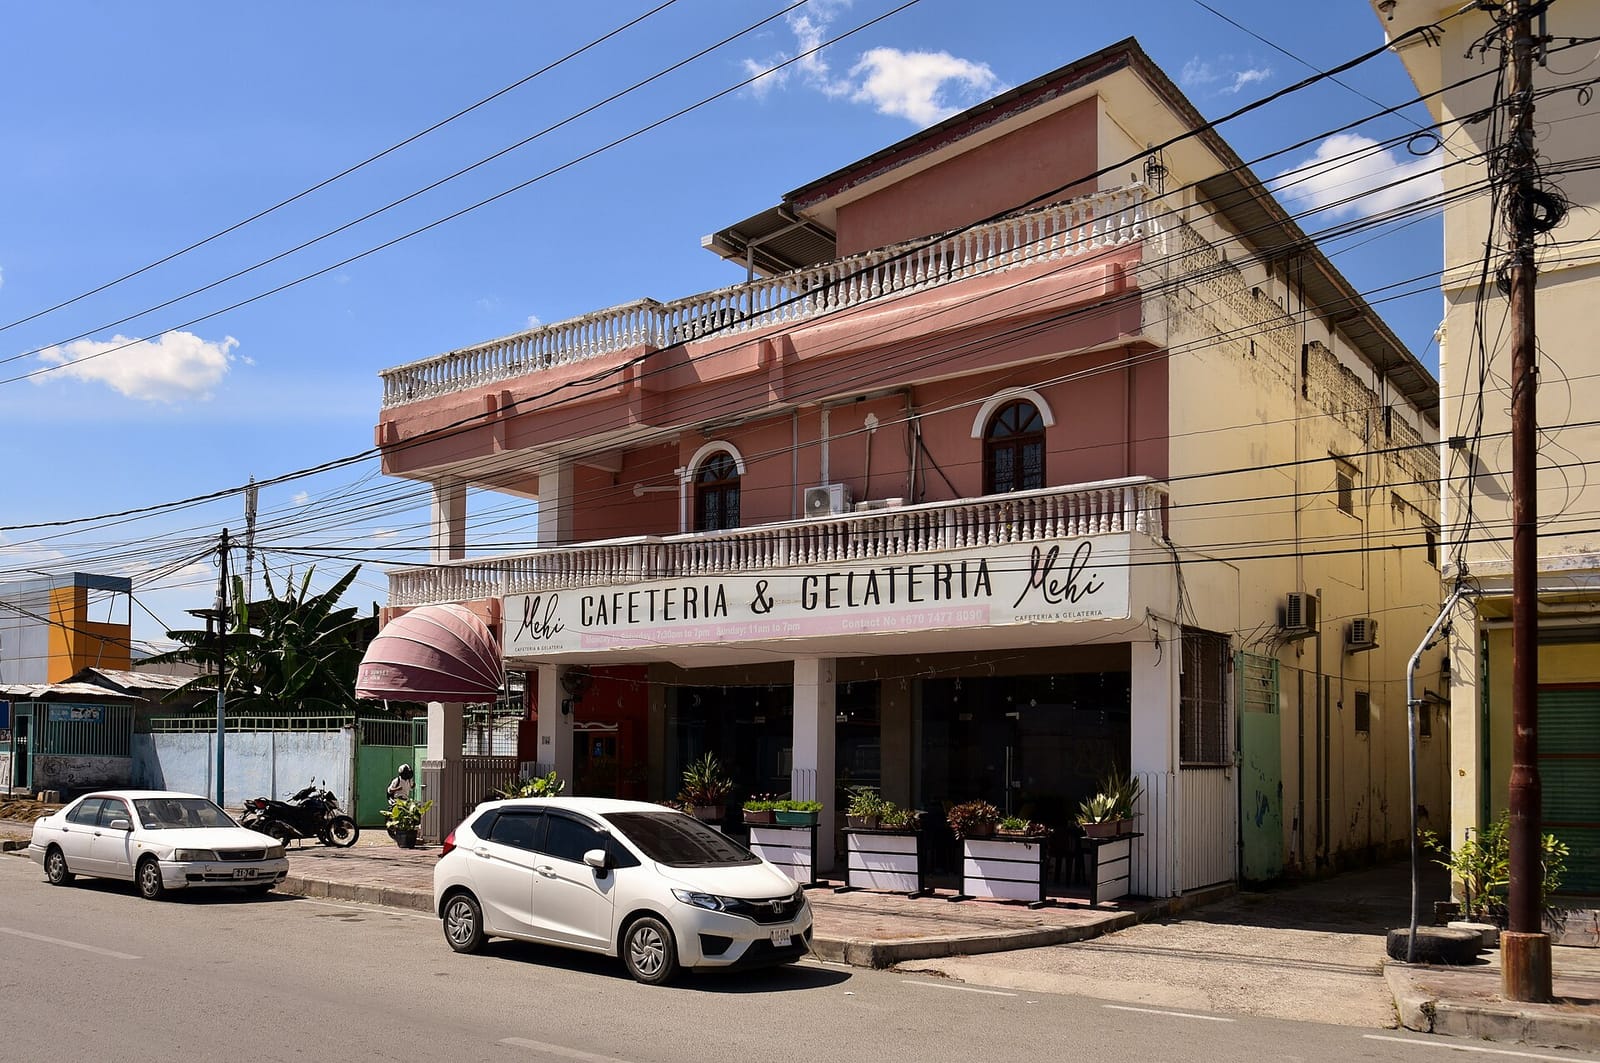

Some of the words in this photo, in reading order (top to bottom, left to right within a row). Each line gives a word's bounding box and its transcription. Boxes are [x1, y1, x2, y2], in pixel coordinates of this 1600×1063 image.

[1013, 541, 1104, 608] Mehi
[580, 583, 729, 627] CAFETERIA
[750, 579, 774, 614] &
[801, 557, 993, 611] GELATERIA
[513, 593, 565, 642] Mehi
[783, 622, 801, 633] 7pm
[841, 617, 881, 629] Contact
[883, 616, 897, 626] No
[1014, 613, 1053, 622] CAFETERIA
[1062, 609, 1104, 619] GELATERIA
